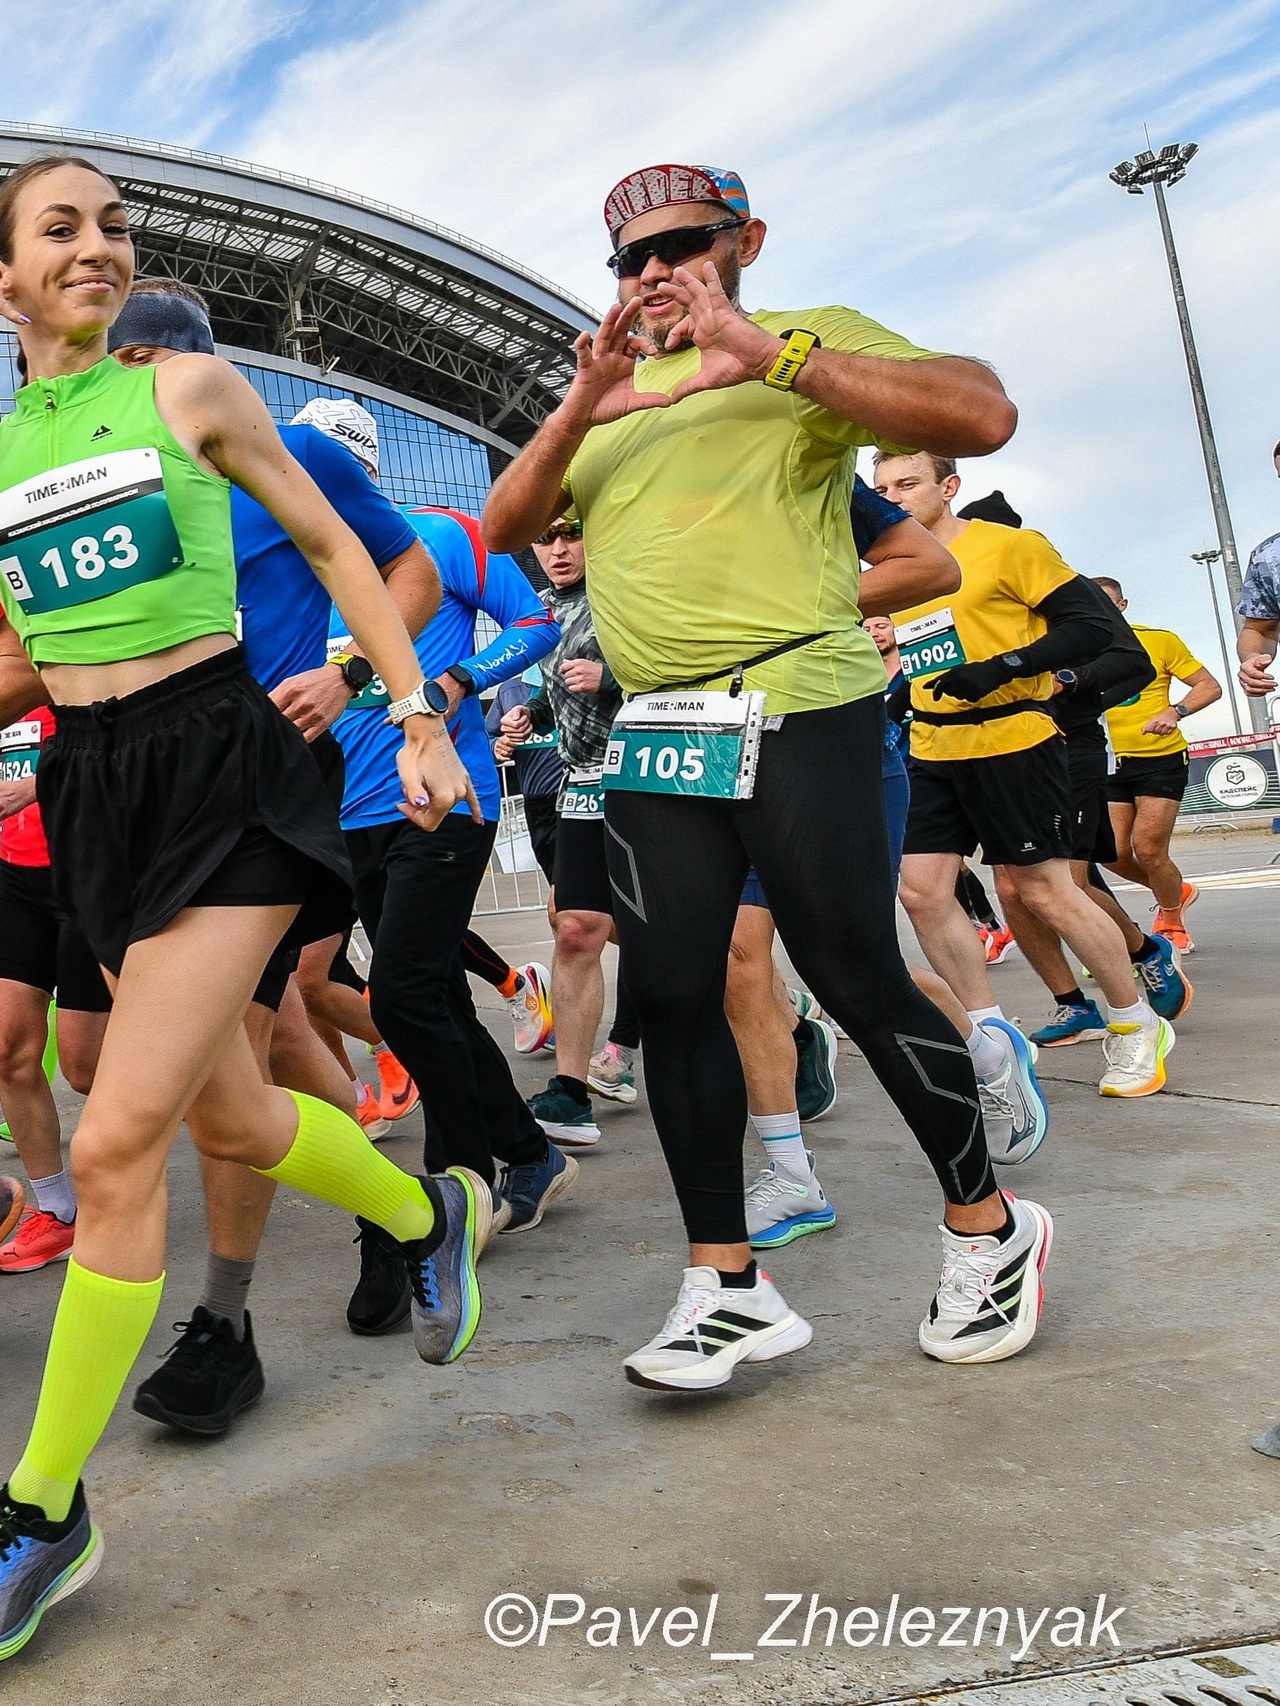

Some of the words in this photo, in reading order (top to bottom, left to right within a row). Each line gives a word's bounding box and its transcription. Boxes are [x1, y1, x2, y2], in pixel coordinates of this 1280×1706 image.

[6, 570, 24, 590] B
[39, 525, 140, 588] 183
[902, 660, 910, 669] B
[911, 641, 958, 670] 1902
[608, 751, 620, 765] B
[635, 746, 705, 781] 105
[566, 798, 574, 806] B
